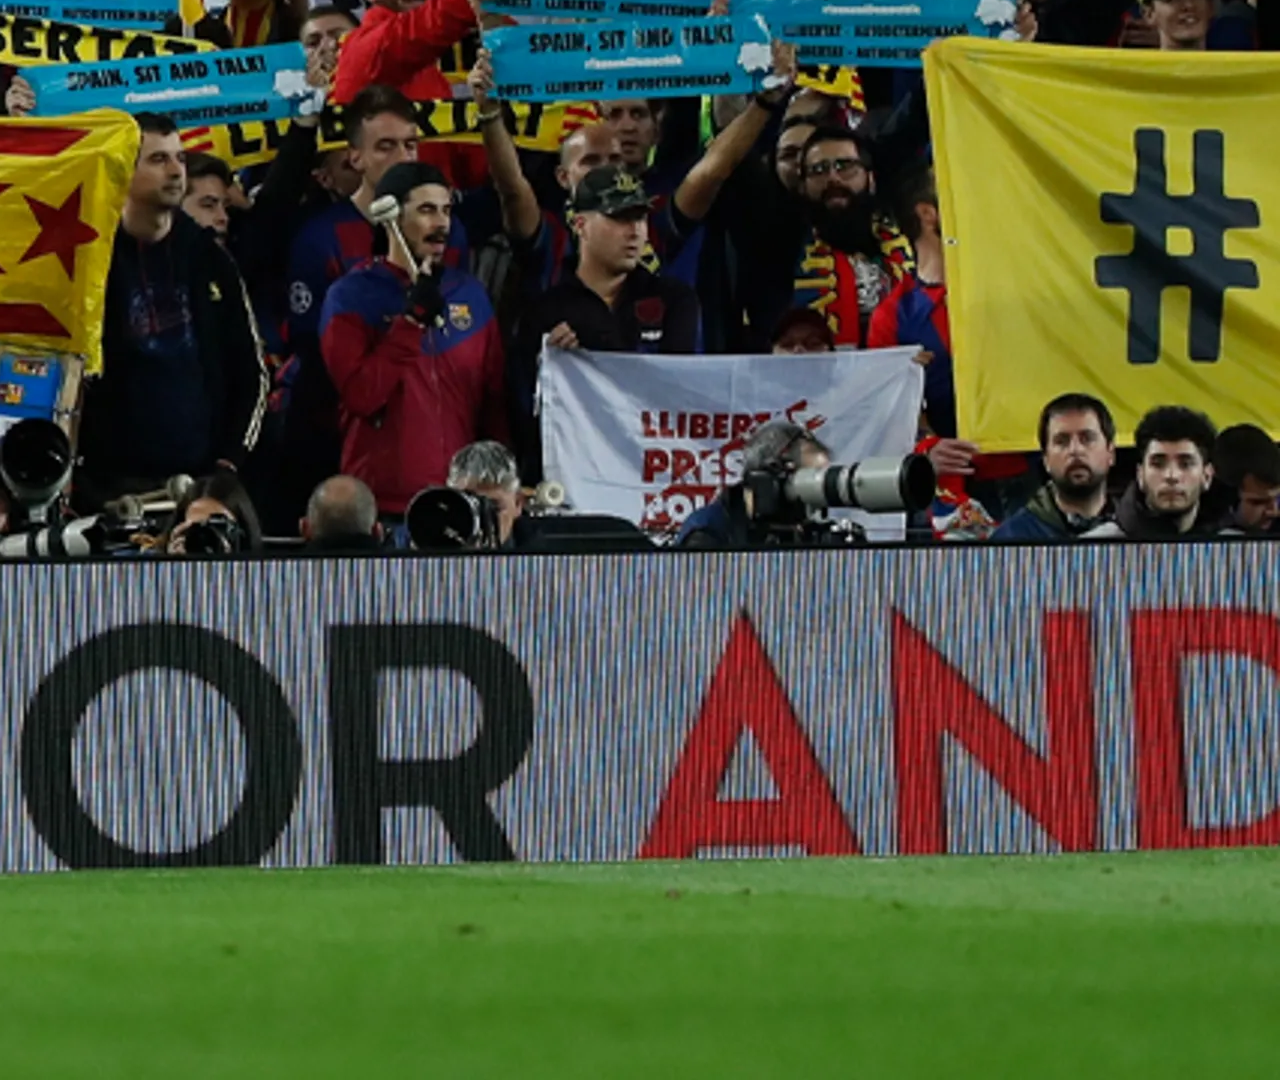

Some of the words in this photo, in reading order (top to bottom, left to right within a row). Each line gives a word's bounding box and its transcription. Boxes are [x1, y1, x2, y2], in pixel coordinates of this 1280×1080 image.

[529, 32, 591, 54] SPAIN,
[599, 29, 626, 50] SIT
[634, 27, 673, 47] AND
[682, 24, 735, 47] TALK!
[67, 67, 130, 93] SPAIN,
[134, 64, 161, 84] SIT
[170, 60, 209, 81] AND
[218, 54, 267, 77] TALK!
[642, 409, 781, 439] LLIBER
[642, 447, 744, 485] PRES
[20, 620, 535, 870] OR
